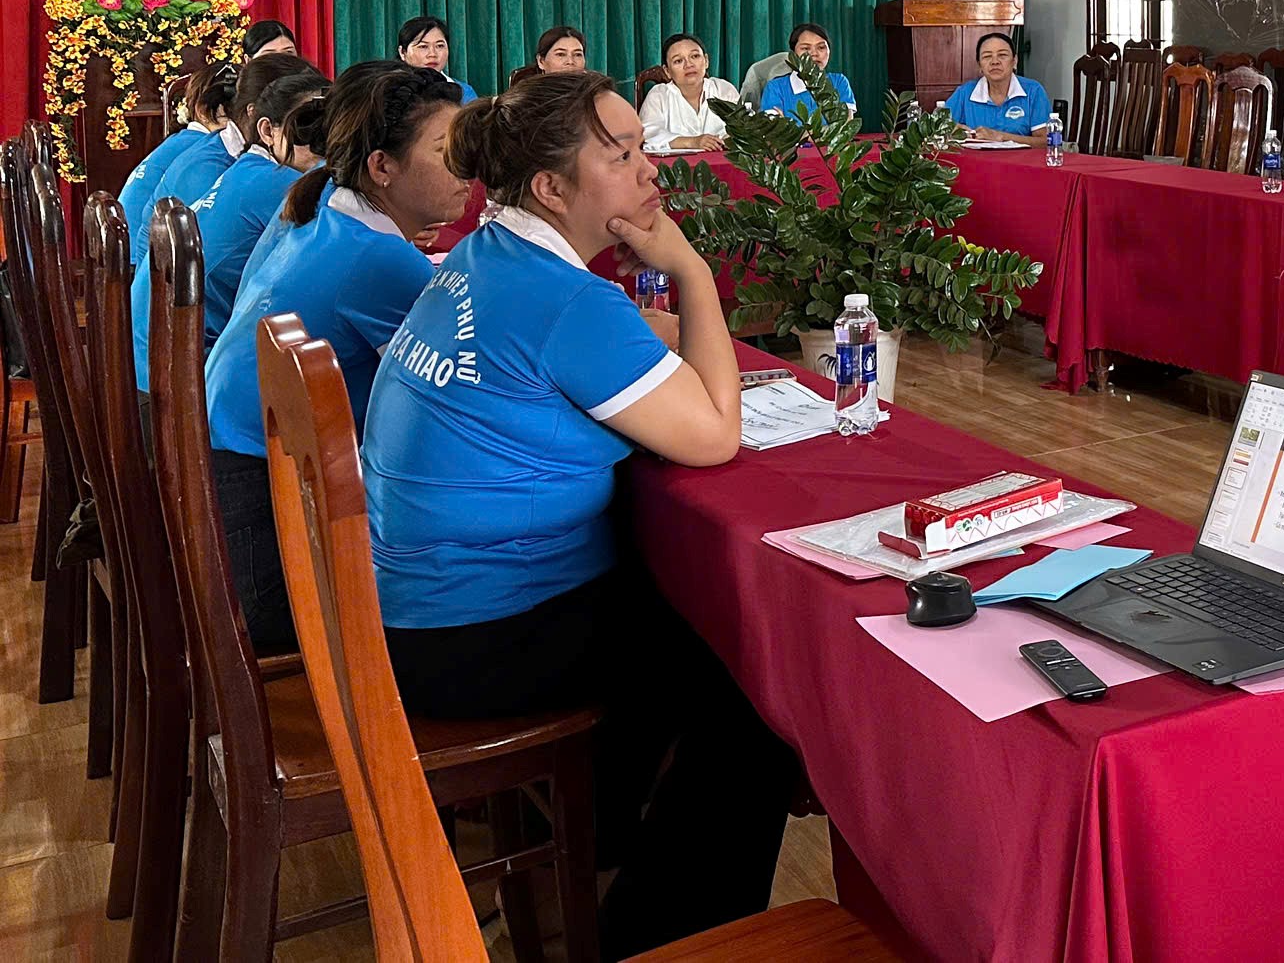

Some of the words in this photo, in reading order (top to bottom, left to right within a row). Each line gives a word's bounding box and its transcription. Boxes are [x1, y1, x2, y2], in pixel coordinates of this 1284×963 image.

[443, 271, 469, 298] HIỆP
[454, 297, 475, 341] PHỤ
[404, 340, 455, 387] HIAO
[456, 351, 481, 384] NỮ
